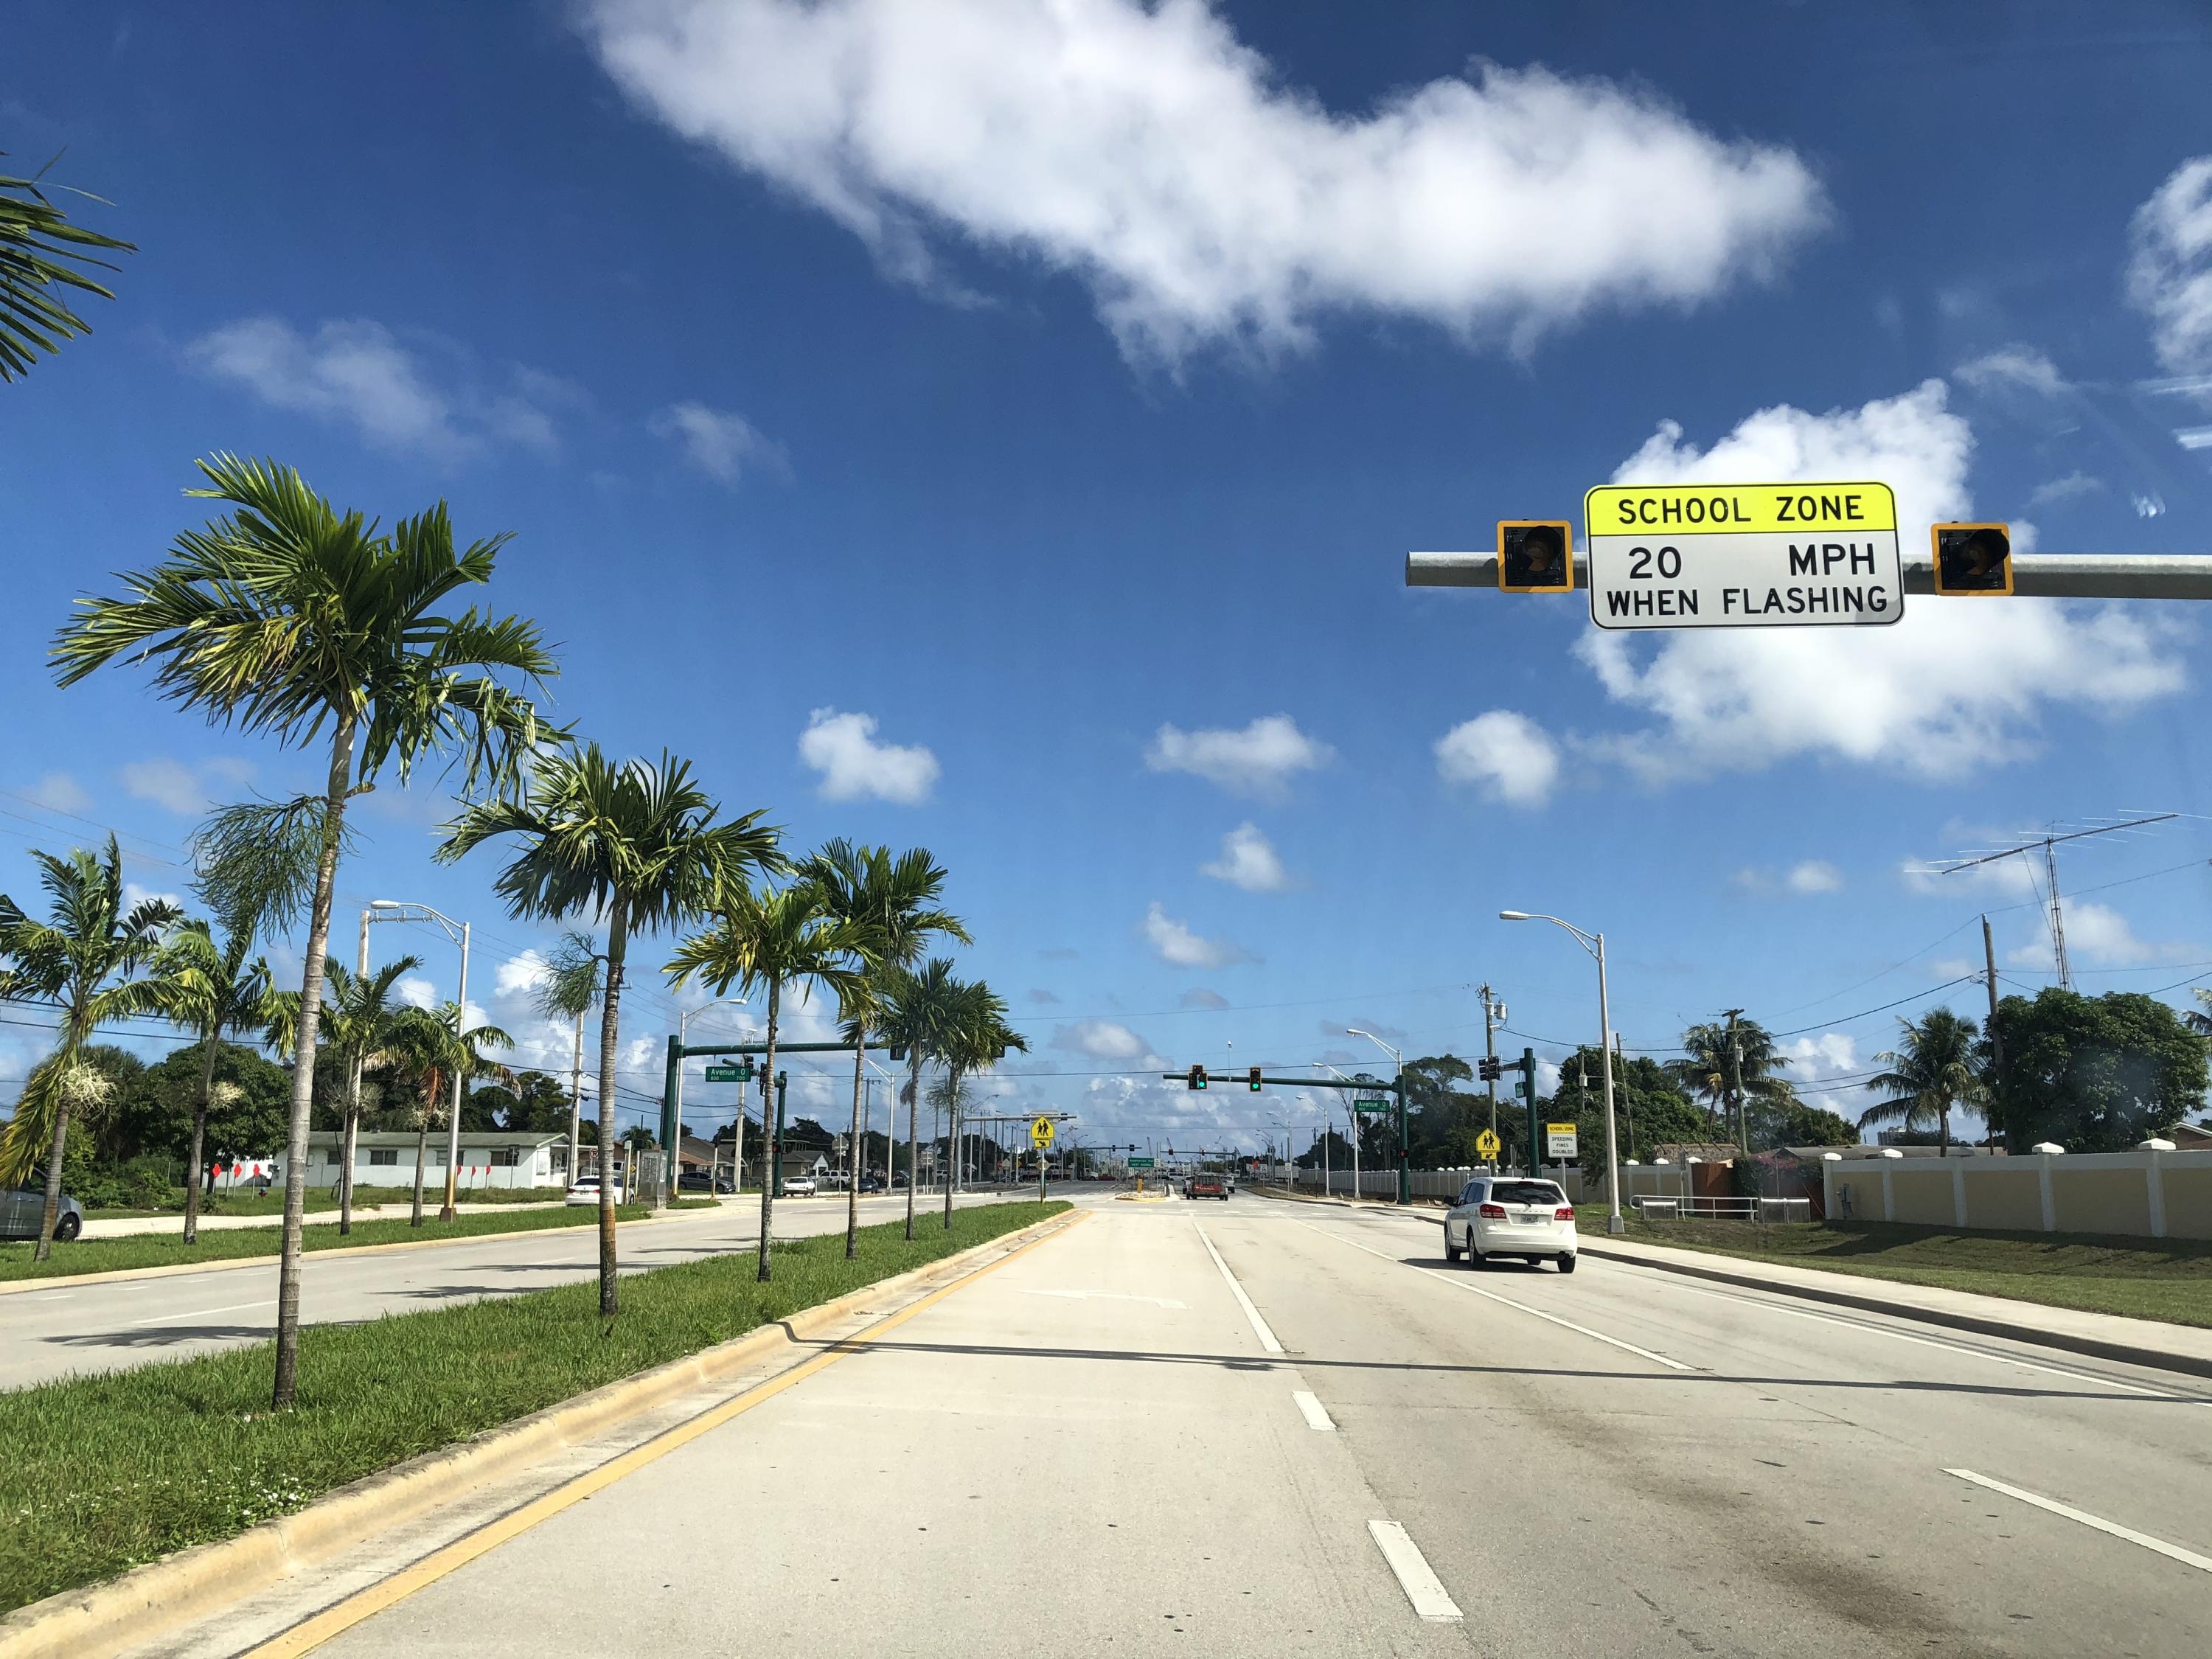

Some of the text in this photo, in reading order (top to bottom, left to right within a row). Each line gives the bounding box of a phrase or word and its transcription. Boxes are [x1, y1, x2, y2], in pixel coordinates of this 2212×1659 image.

[1618, 495, 1864, 524] SCHOOL ZONE
[1628, 543, 1875, 579] 20 MPH
[1607, 585, 1888, 616] WHEN FLASHING
